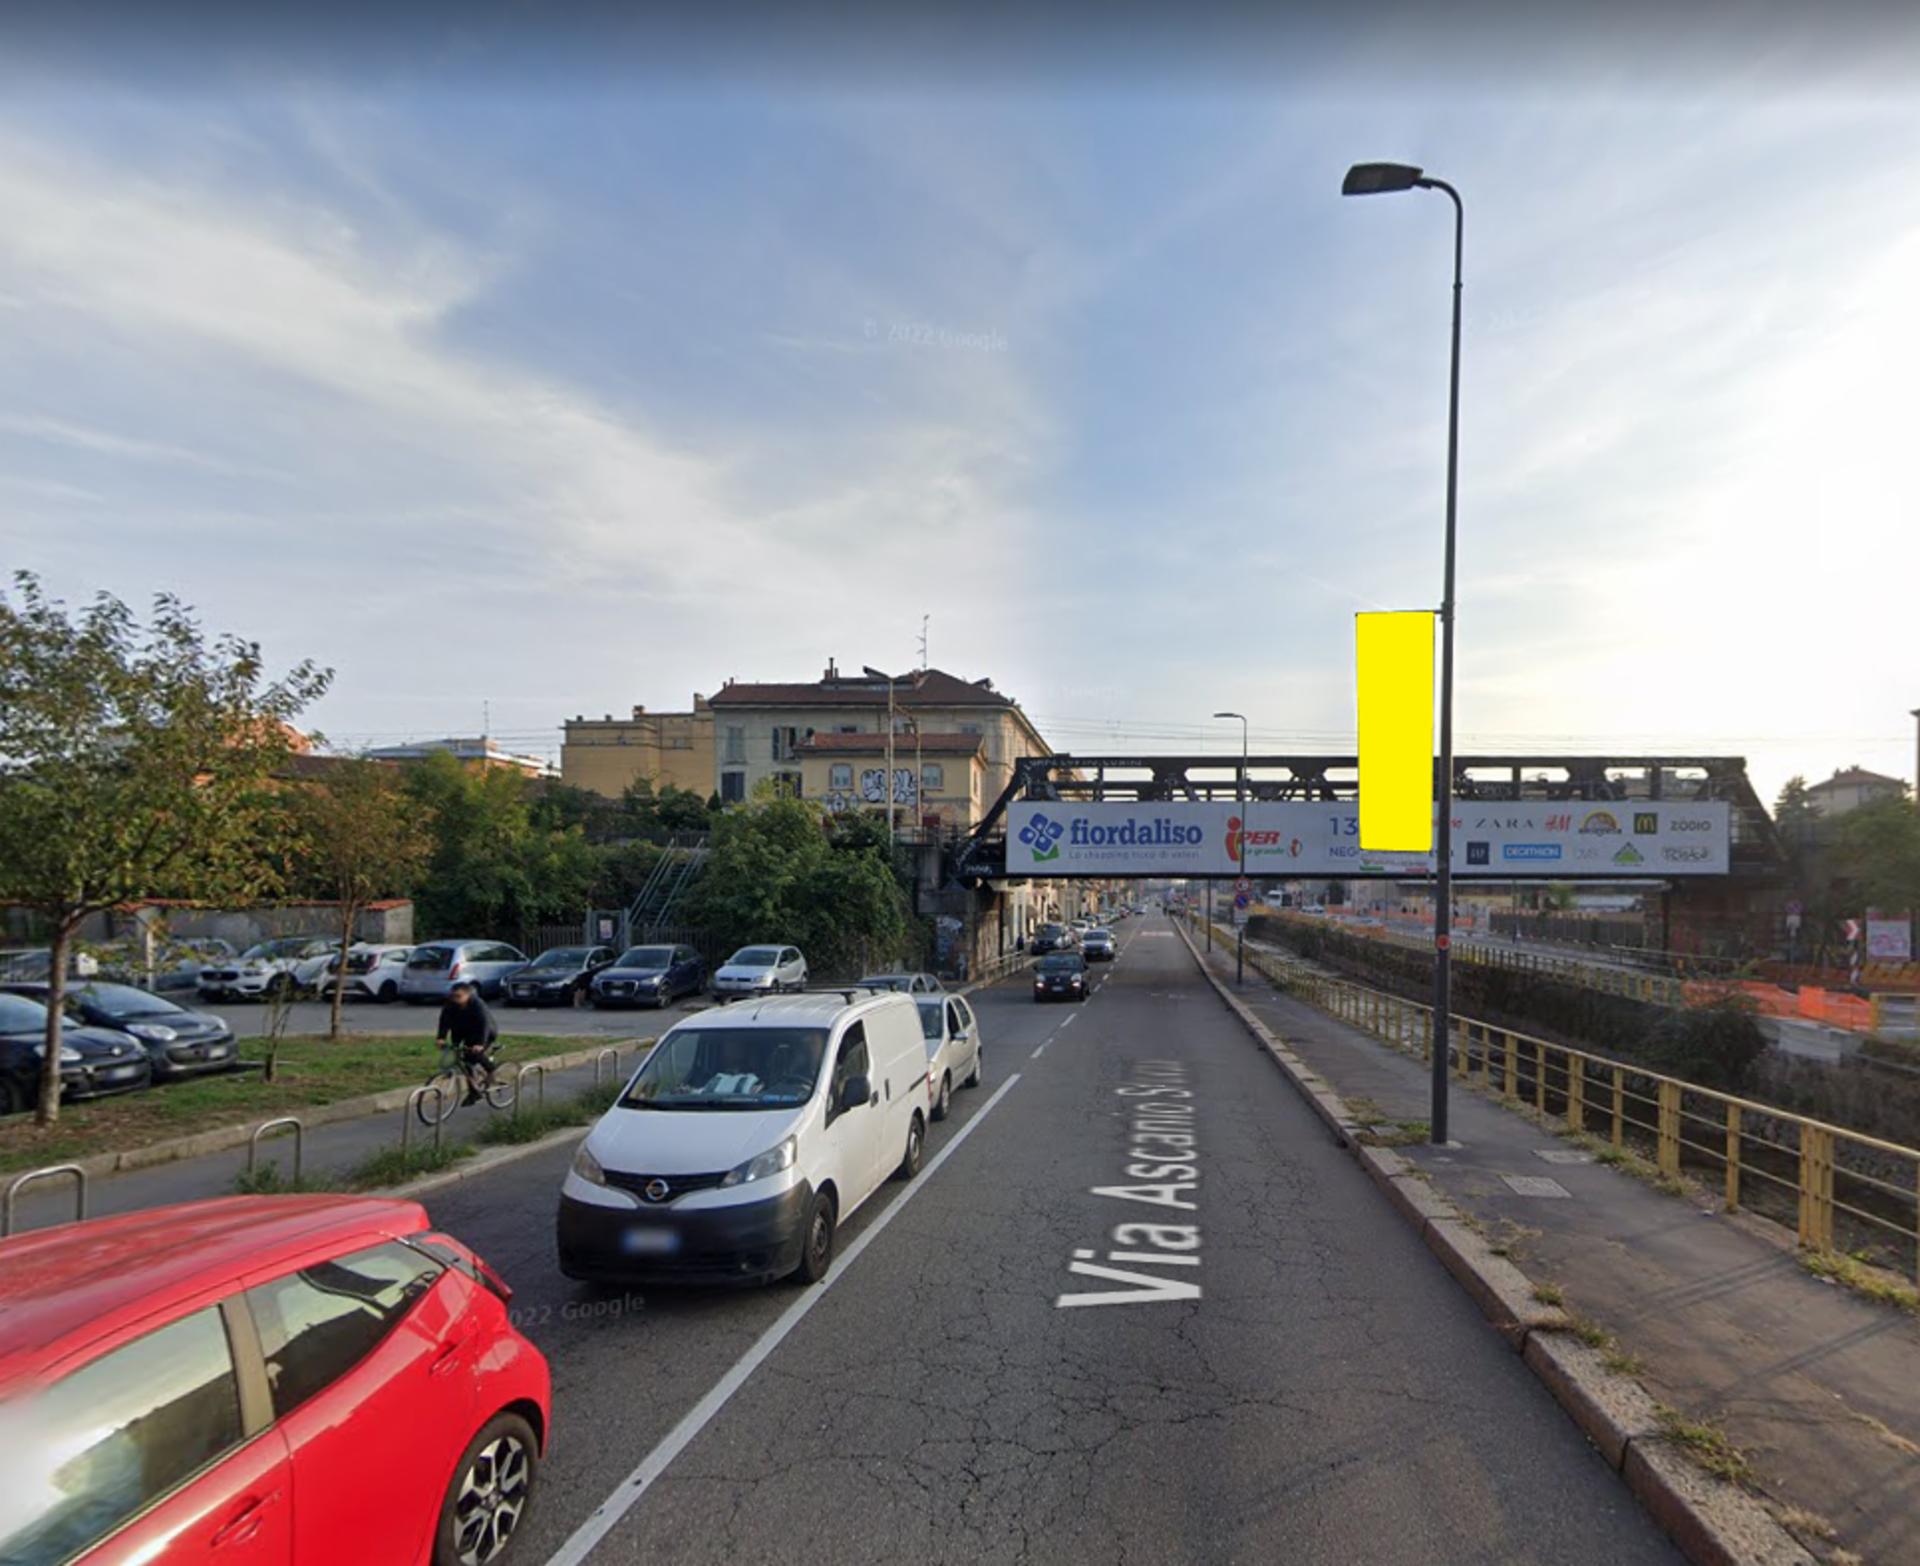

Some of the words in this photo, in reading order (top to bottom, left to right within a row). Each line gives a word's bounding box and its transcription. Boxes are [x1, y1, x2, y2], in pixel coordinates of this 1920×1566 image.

[1476, 818, 1534, 829] ZARA
[1070, 818, 1203, 845] fiordaliso
[1506, 847, 1559, 857] DECATHLON
